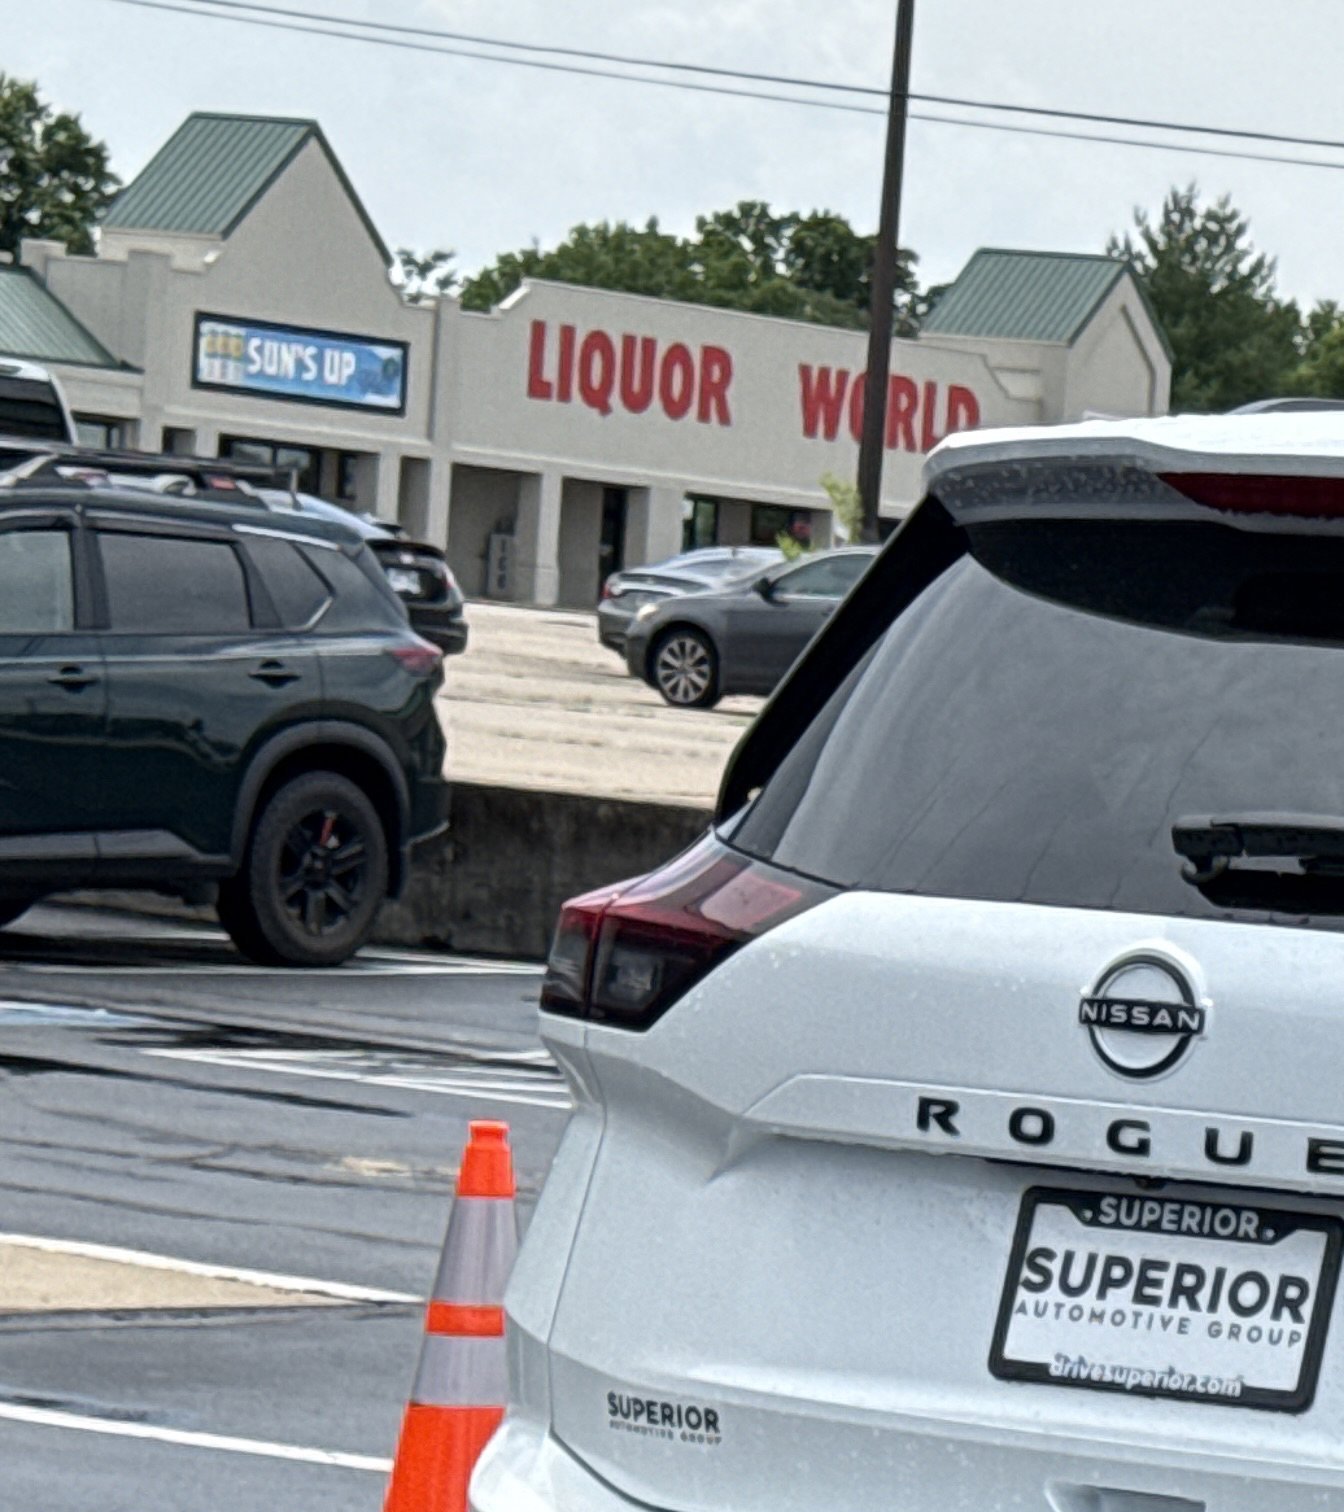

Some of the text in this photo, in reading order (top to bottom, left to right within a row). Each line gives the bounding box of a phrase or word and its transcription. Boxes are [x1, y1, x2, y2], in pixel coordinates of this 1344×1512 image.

[247, 337, 356, 386] SUN'S UP
[527, 319, 733, 427] LIQUOR
[1081, 1001, 1200, 1031] NISSAN
[1099, 1196, 1260, 1239] SUPERIOR
[1019, 1247, 1311, 1325] SUPERIOR
[1014, 1299, 1302, 1348] AUTOMOTIVE GROUP
[1048, 1353, 1243, 1398] drivesuperior.com
[607, 1391, 720, 1434] SUPERIOR
